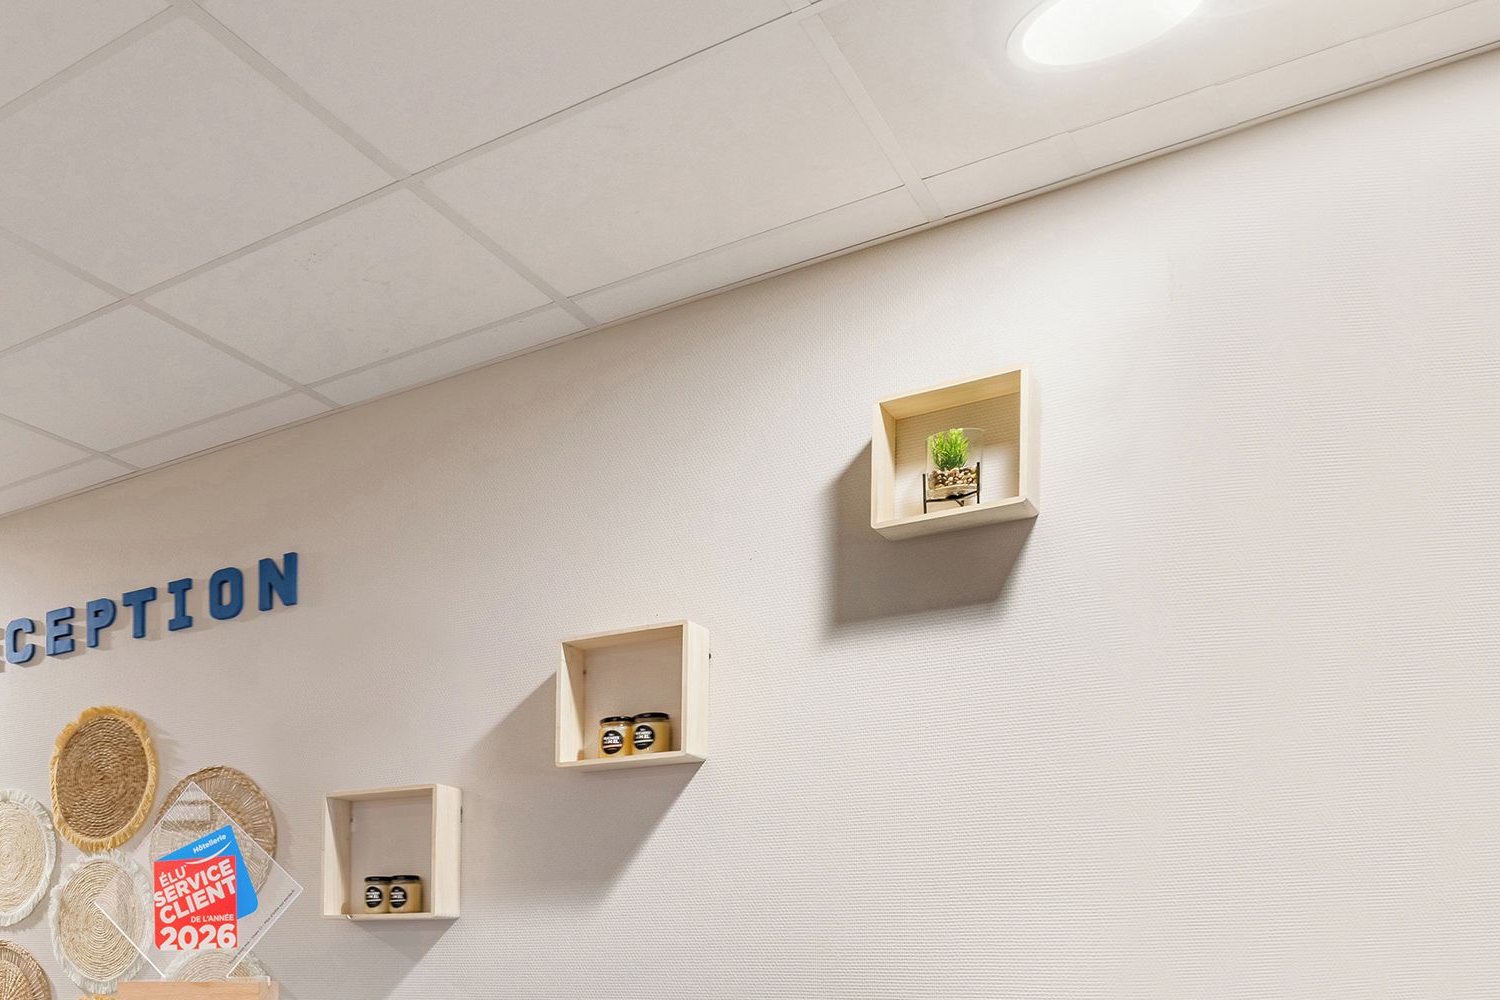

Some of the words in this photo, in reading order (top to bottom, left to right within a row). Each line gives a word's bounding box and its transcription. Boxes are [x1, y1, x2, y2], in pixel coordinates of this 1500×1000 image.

[192, 834, 227, 854] Hôtellerie
[153, 858, 234, 907] SERVICE
[159, 874, 237, 924] CLIENT
[190, 915, 201, 923] DE
[202, 913, 235, 922] L'ANNÉE
[159, 922, 237, 951] 2026
